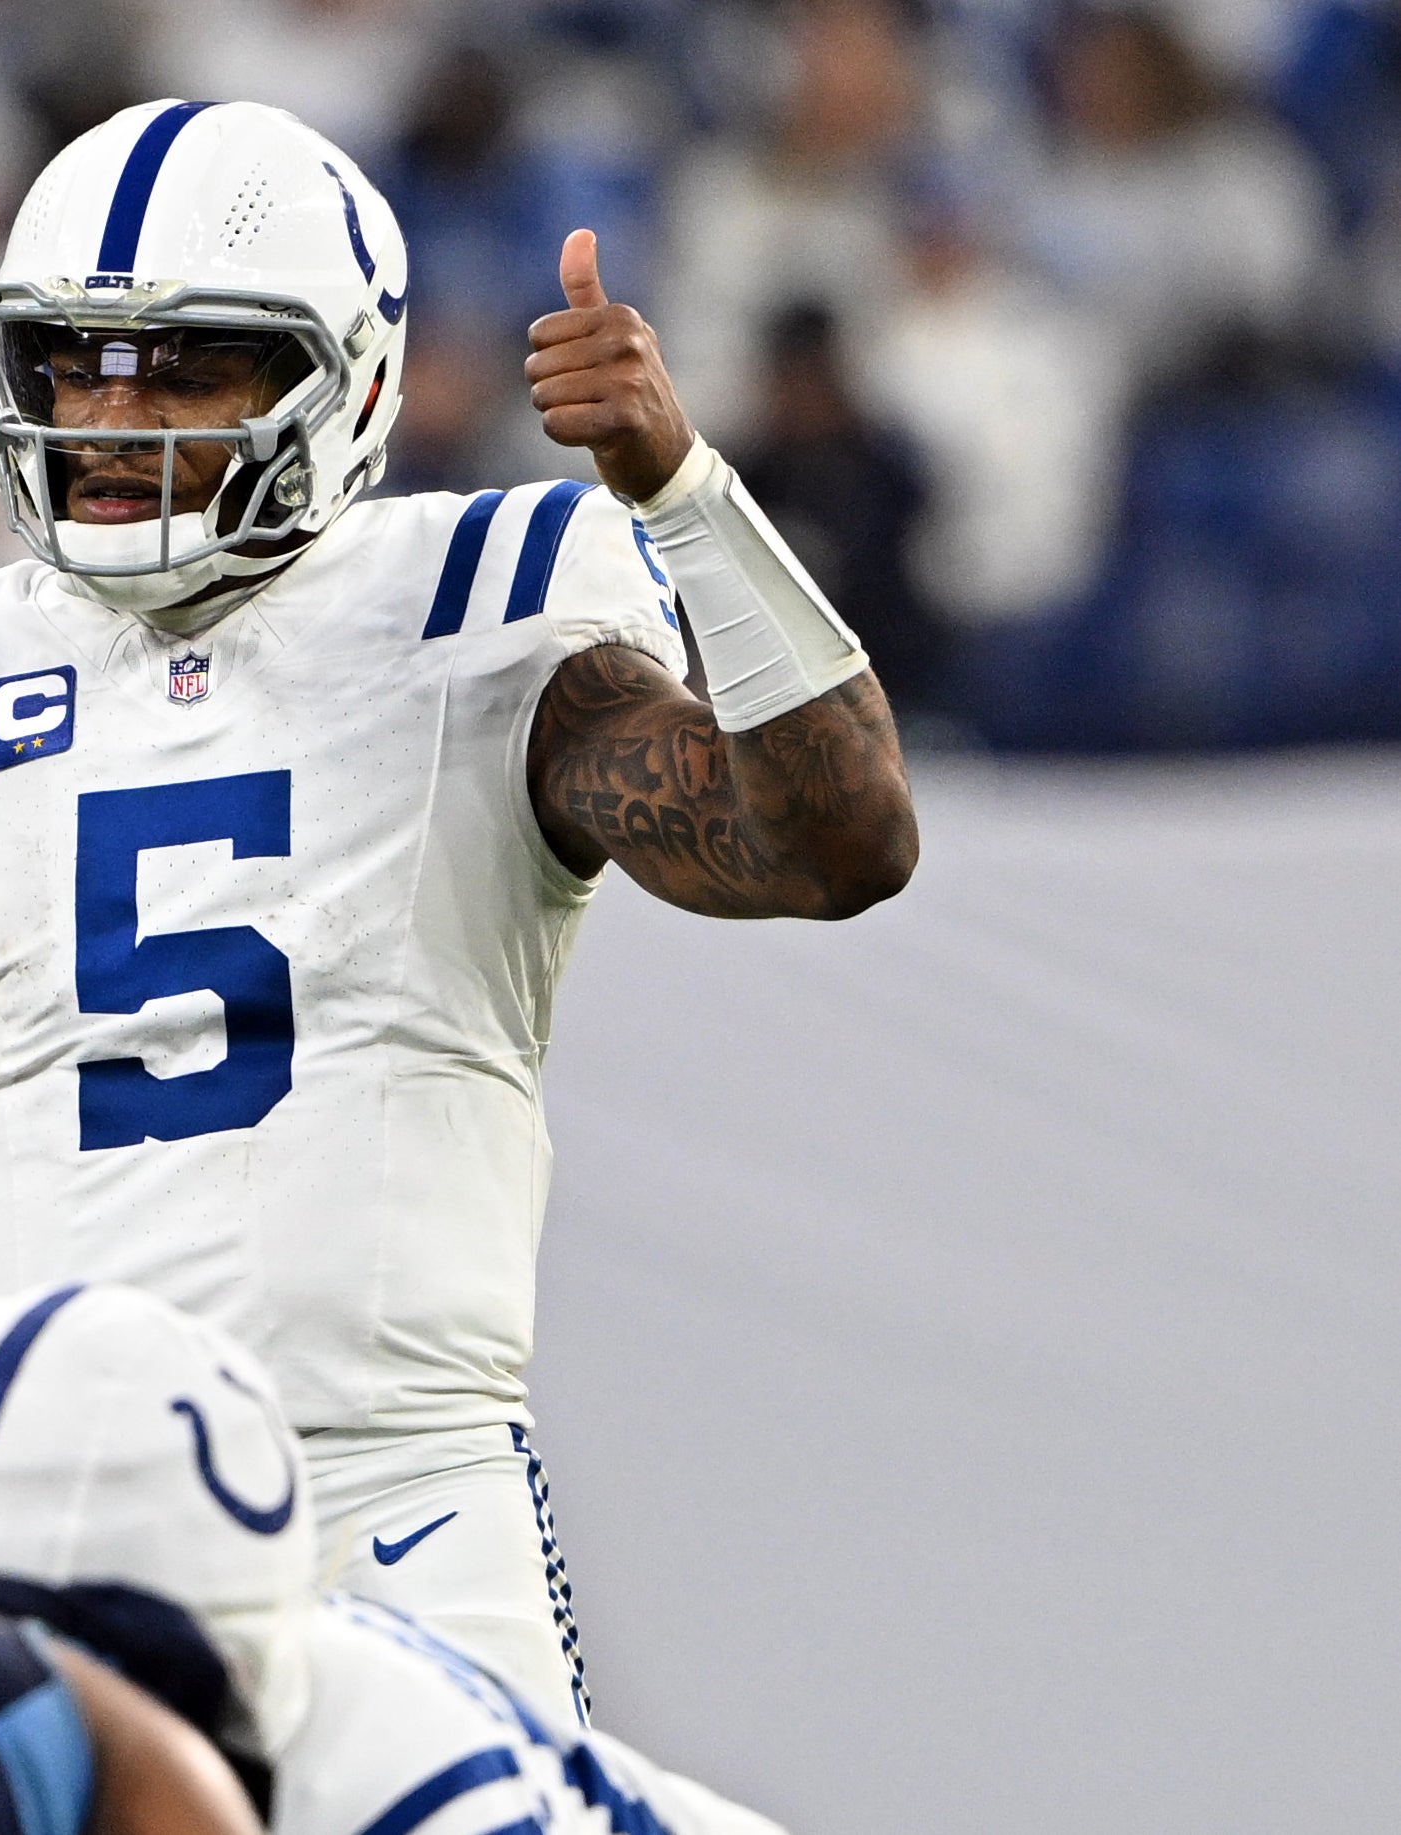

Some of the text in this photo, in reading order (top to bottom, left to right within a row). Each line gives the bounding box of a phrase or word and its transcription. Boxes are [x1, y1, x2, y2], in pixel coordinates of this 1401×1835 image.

[85, 275, 134, 289] COLTS
[173, 674, 205, 697] NFL
[75, 769, 295, 1151] 5
